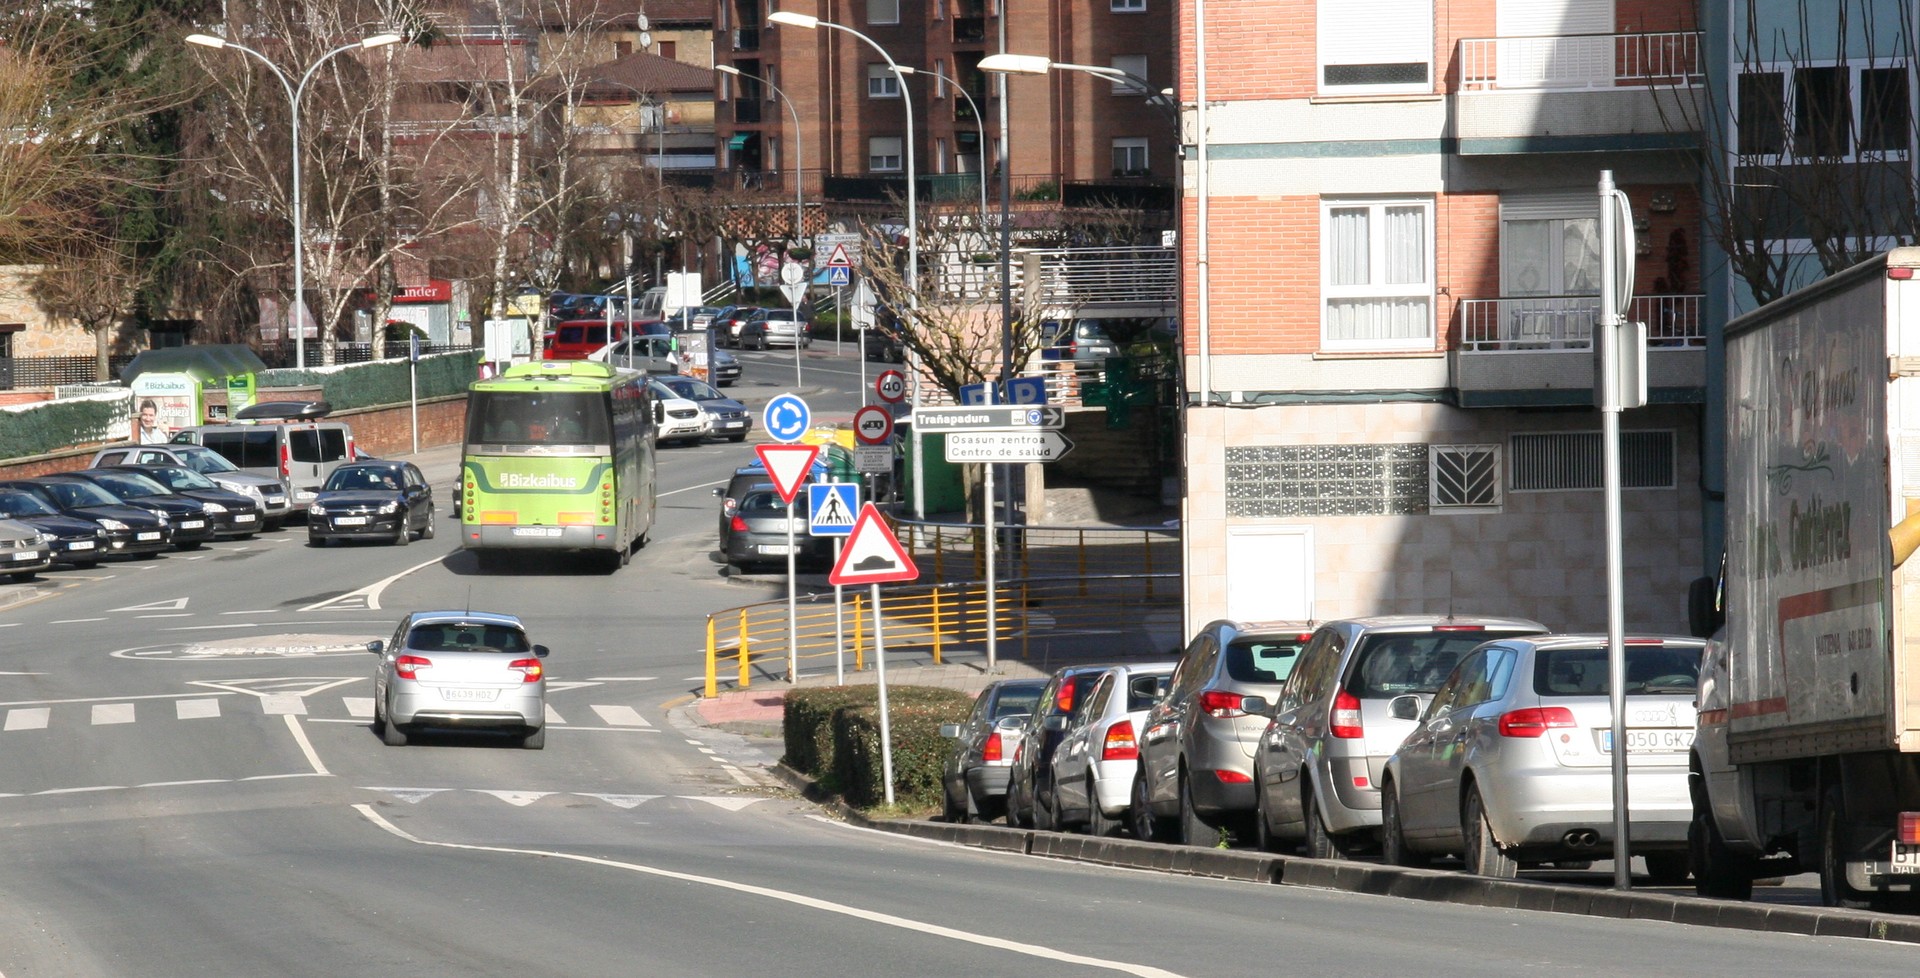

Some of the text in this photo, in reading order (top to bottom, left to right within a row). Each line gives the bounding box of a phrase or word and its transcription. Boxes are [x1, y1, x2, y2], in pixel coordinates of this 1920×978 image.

[150, 381, 186, 390] Bizkaibus
[883, 381, 901, 392] 40
[1015, 383, 1037, 404] P
[917, 413, 990, 426] Trañapadura
[952, 435, 1046, 444] Osasun zentroa
[951, 447, 1051, 456] Centro de salud
[509, 473, 576, 487] Bizkaibus
[1664, 732, 1695, 747] GKZ
[1864, 861, 1883, 875] EL
